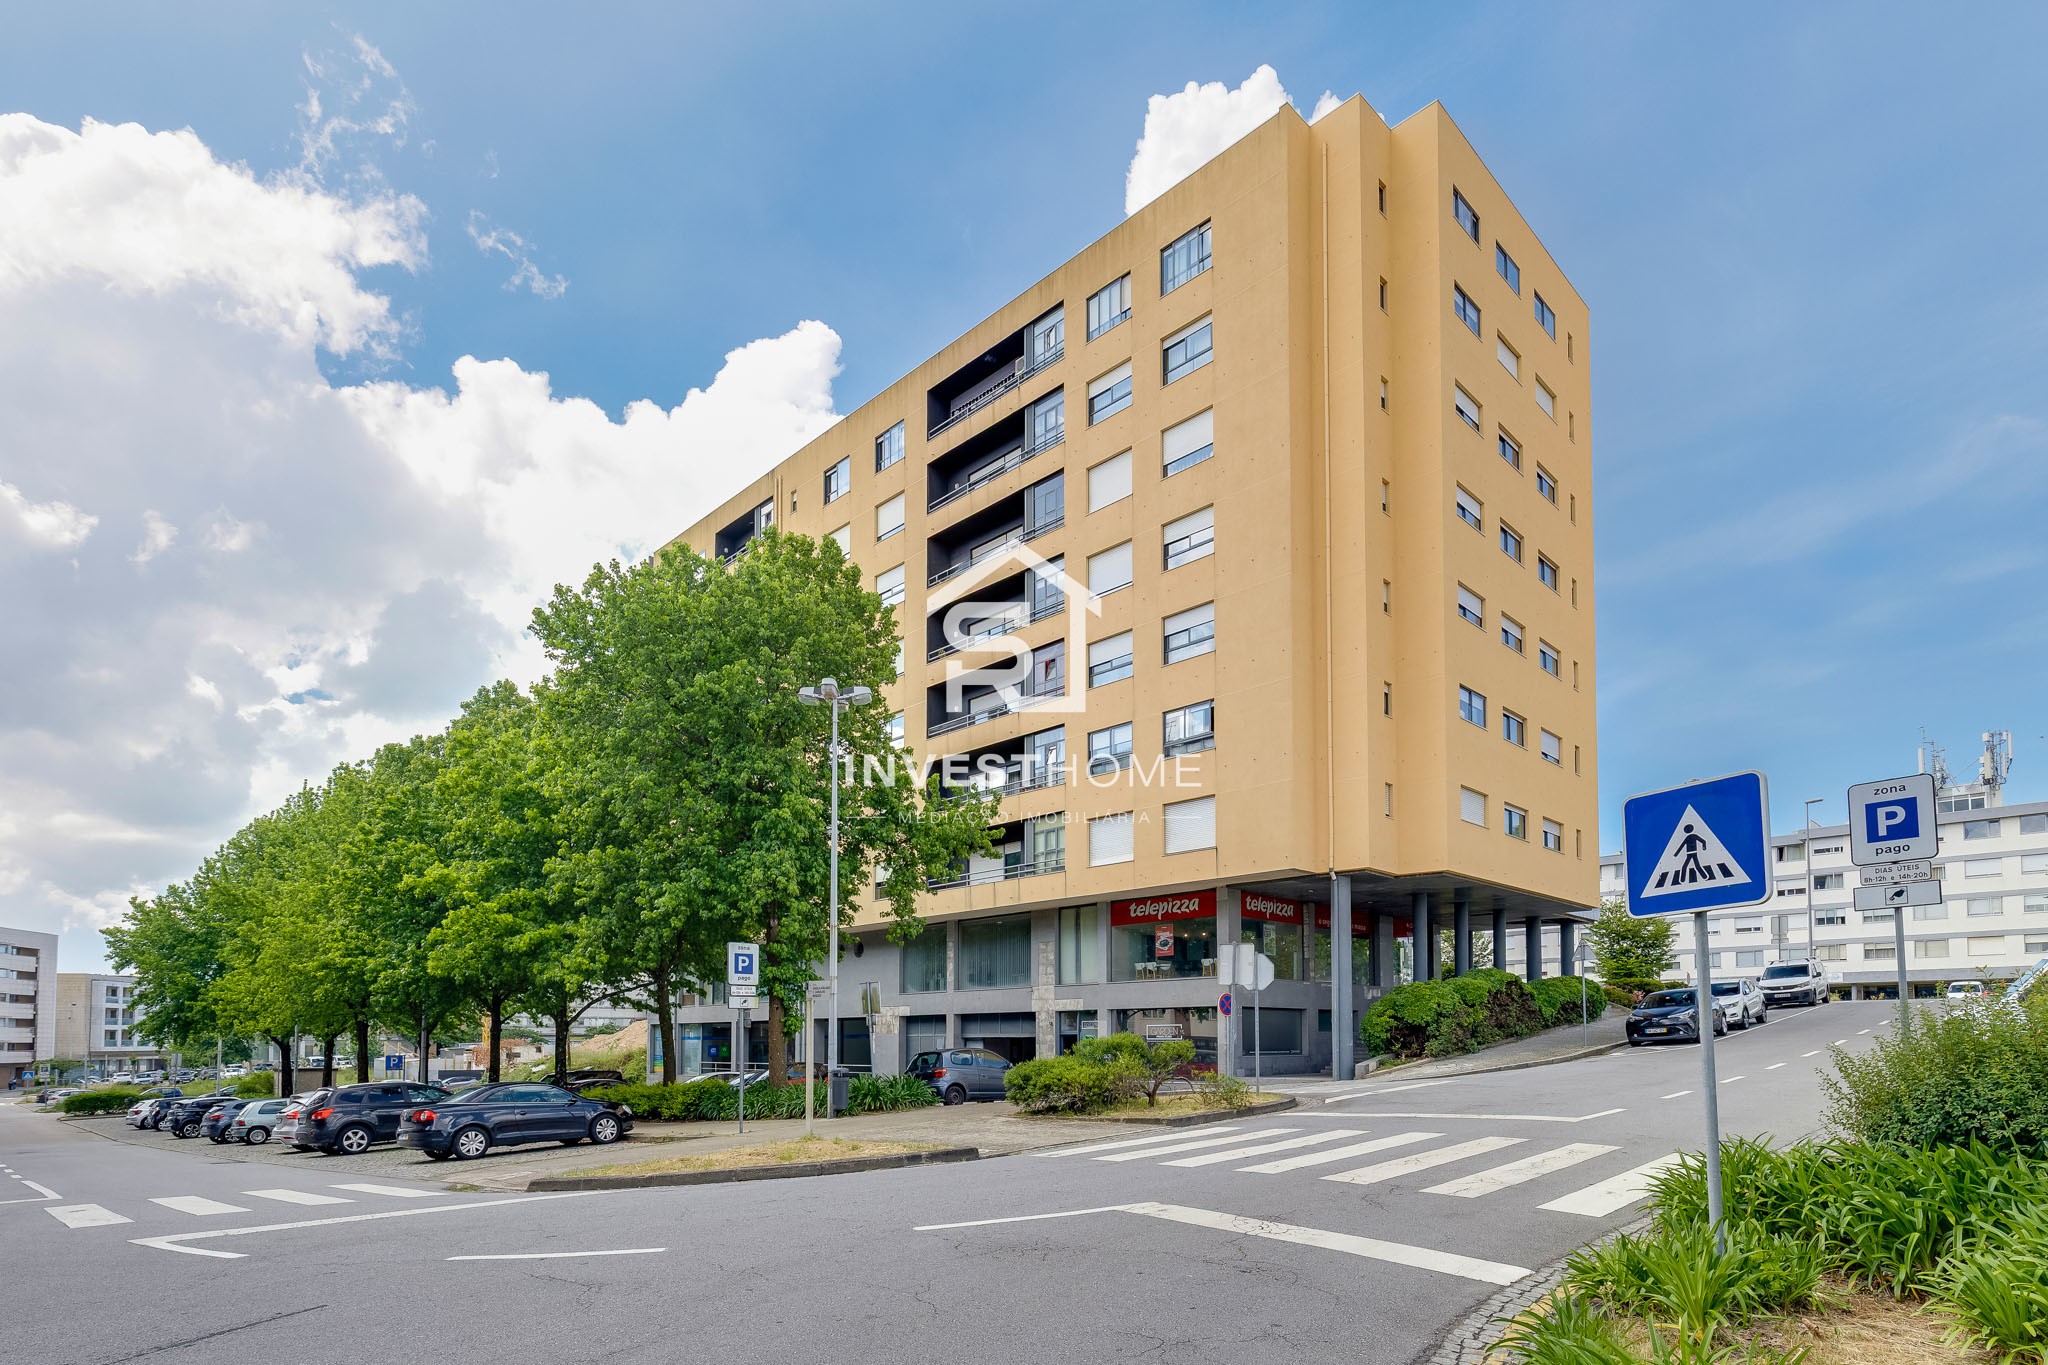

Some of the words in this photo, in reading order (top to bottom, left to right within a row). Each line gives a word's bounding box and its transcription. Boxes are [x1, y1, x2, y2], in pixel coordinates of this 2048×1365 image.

[1874, 784, 1906, 795] zona
[1876, 805, 1906, 837] P
[1875, 844, 1910, 856] pago
[1875, 866, 1893, 874] DIAS
[1896, 864, 1920, 872] ÚTEIS
[1129, 898, 1199, 920] telepizza
[1245, 895, 1294, 919] telepizza
[738, 955, 750, 972] P
[1151, 1026, 1179, 1036] GARDEN
[390, 1057, 398, 1067] P
